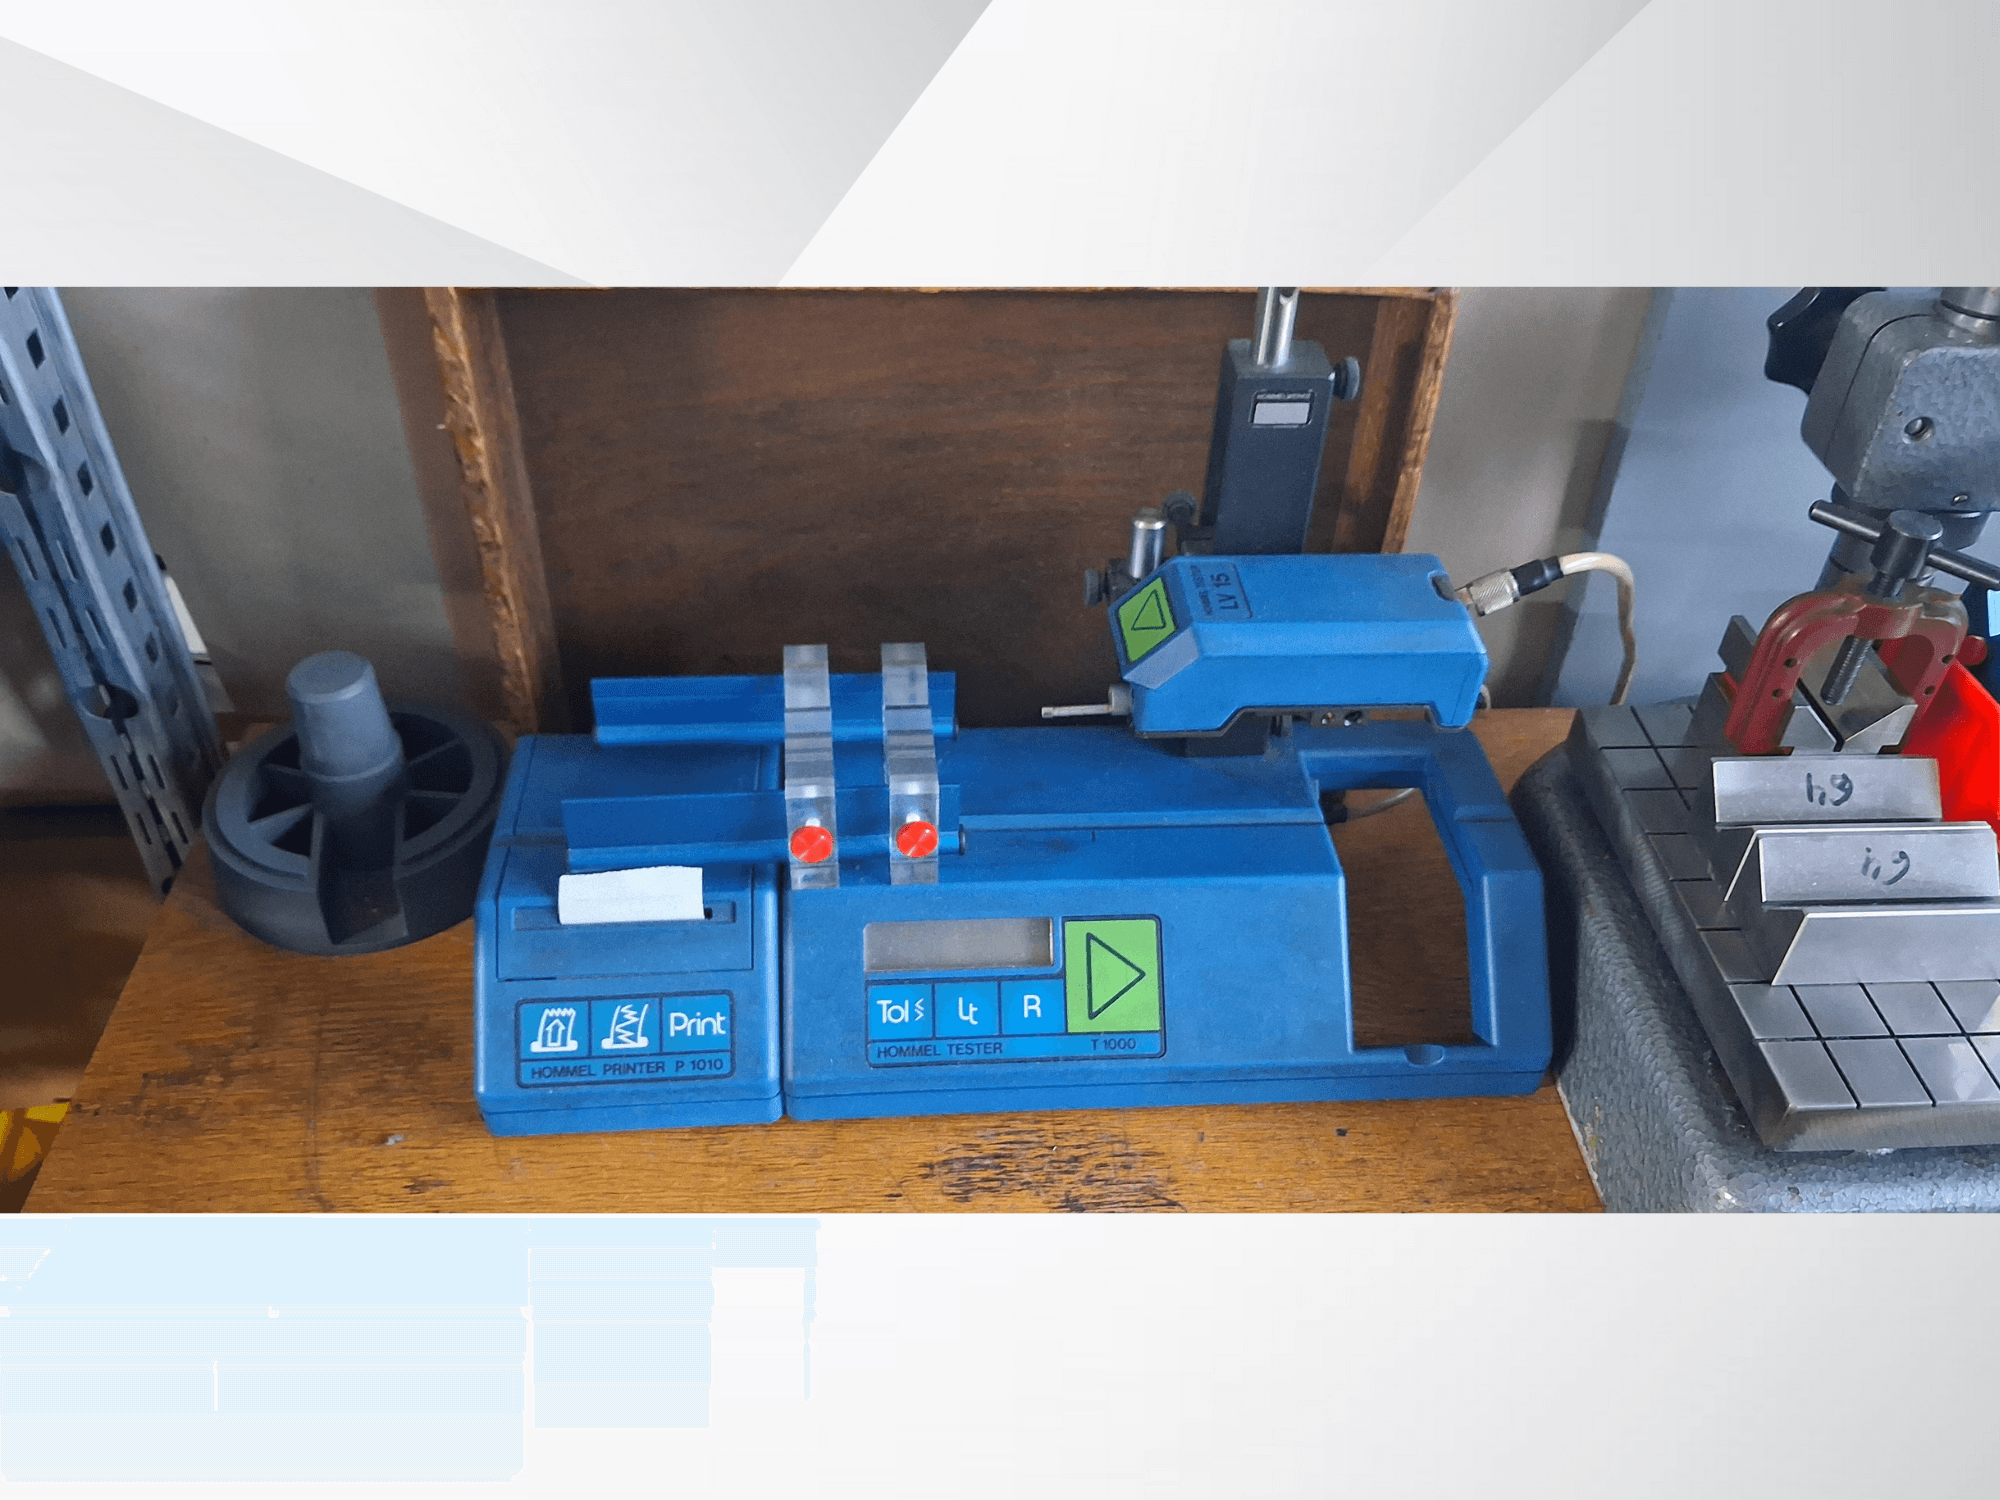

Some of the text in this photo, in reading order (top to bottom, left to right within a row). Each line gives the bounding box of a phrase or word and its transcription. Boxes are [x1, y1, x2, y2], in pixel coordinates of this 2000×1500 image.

[1210, 572, 1239, 611] LV 15
[876, 999, 909, 1023] Tol
[1023, 994, 1042, 1018] R
[669, 1012, 726, 1037] Print
[876, 1037, 1137, 1059] HOMMEL TESTER T 1000
[531, 1058, 724, 1079] HOMMEL PRINTER P 1010
